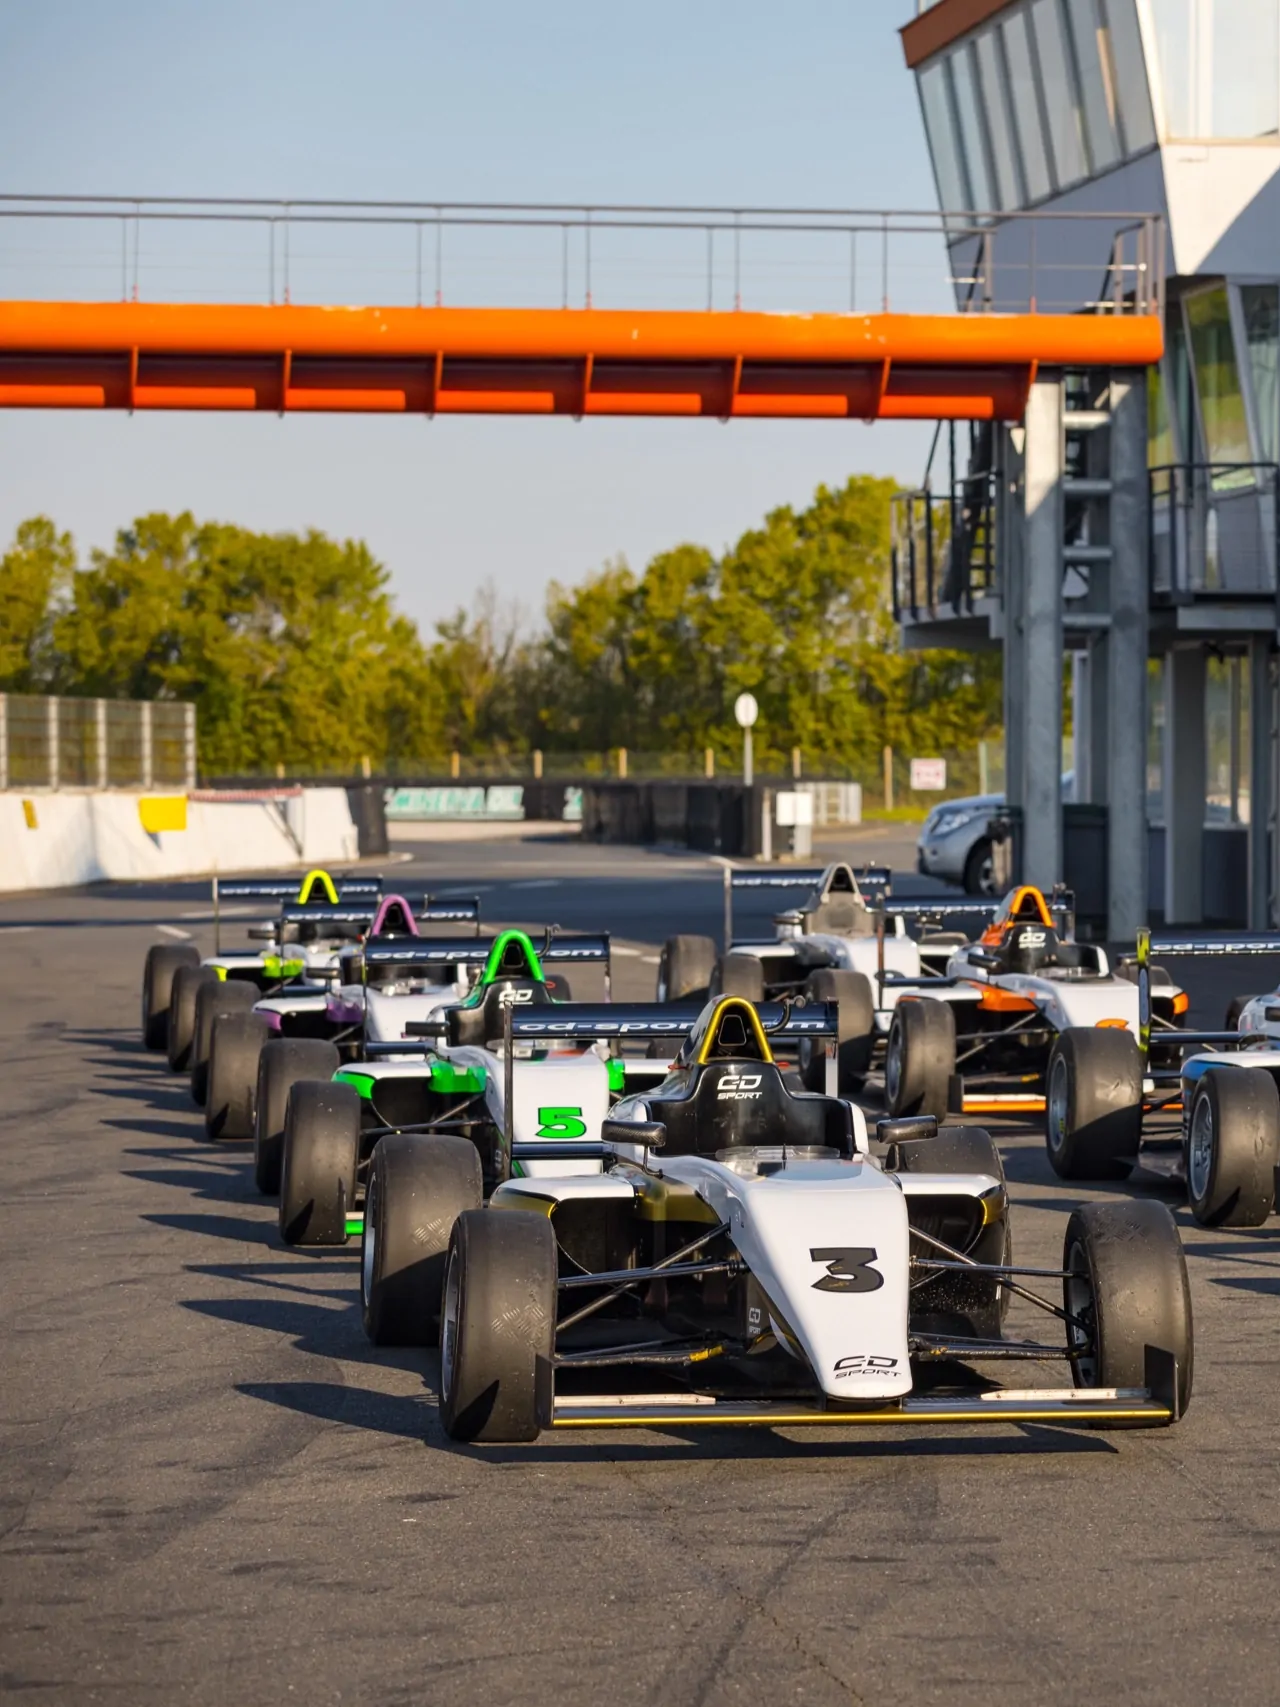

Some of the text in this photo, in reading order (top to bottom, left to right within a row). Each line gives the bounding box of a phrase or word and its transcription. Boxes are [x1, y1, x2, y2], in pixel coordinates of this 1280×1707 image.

[717, 1091, 763, 1100] SPORT
[535, 1106, 587, 1139] 5
[809, 1247, 885, 1293] 3
[834, 1368, 901, 1380] SPORT
